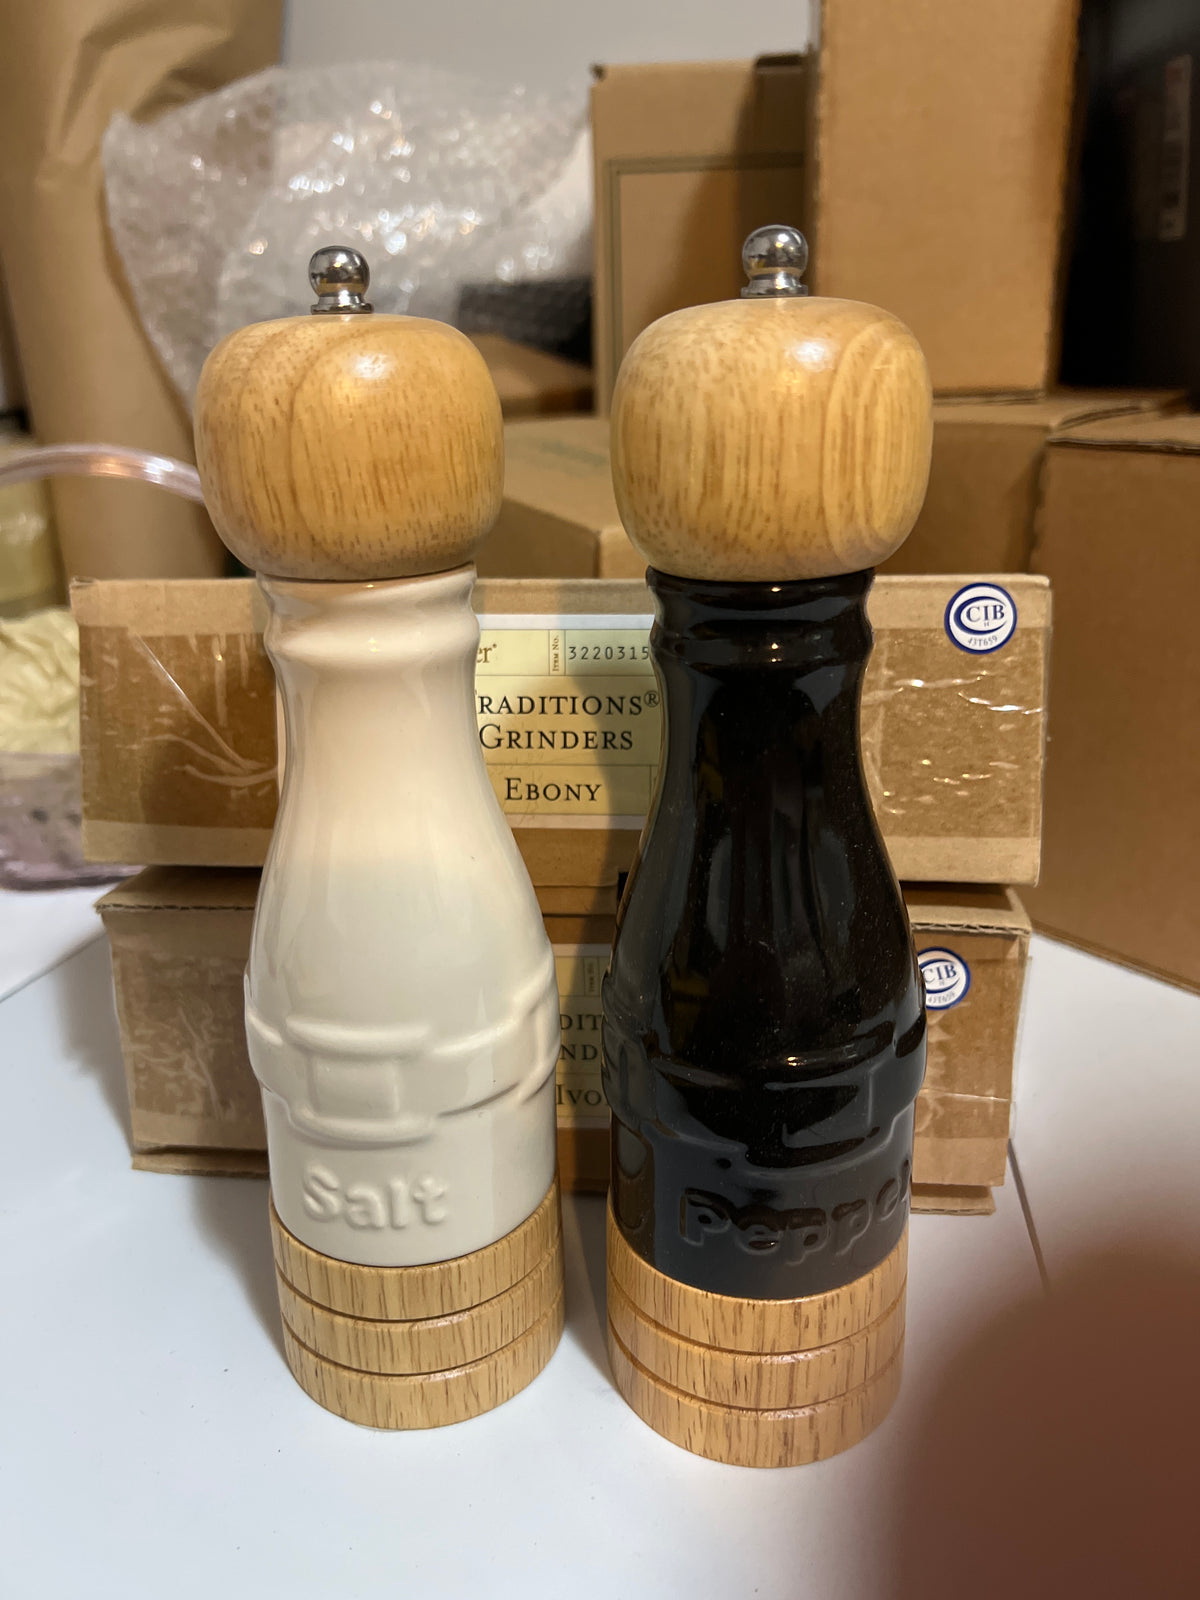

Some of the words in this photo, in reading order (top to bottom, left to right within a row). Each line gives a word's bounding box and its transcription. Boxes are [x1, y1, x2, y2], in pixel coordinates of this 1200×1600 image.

[568, 646, 649, 660] 3220315
[474, 690, 660, 716] RADITIONS®
[556, 1084, 608, 1106] IVO
[303, 1160, 449, 1230] Salt
